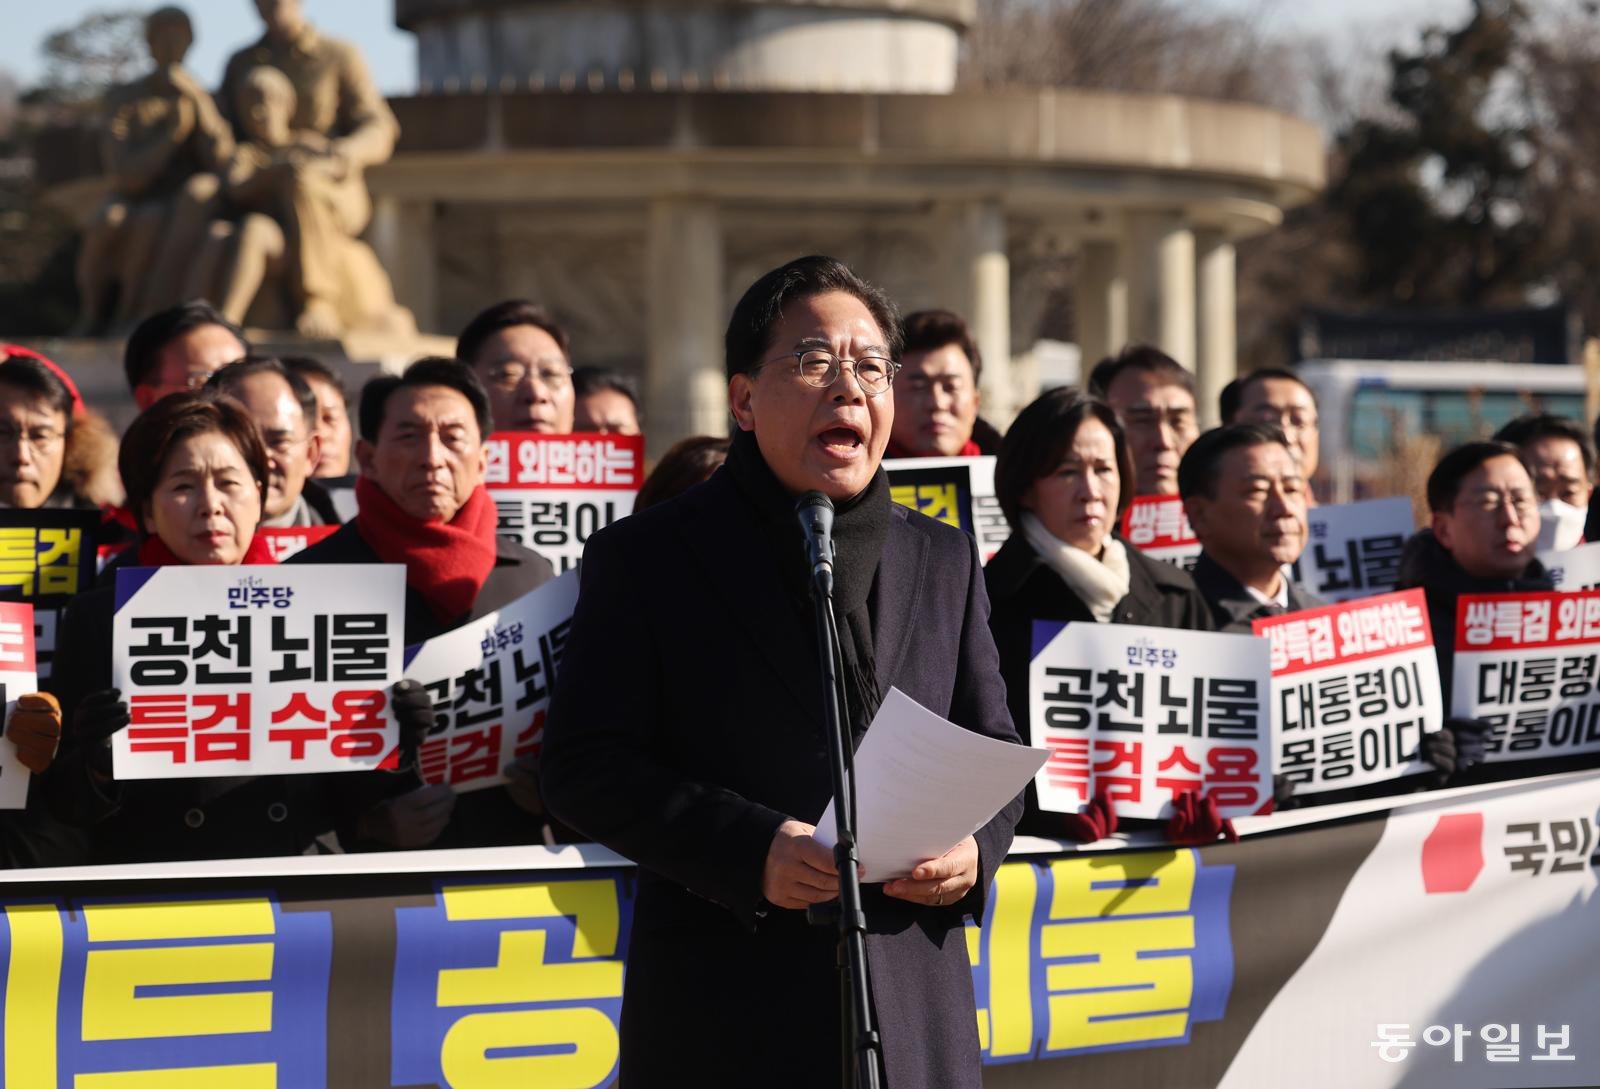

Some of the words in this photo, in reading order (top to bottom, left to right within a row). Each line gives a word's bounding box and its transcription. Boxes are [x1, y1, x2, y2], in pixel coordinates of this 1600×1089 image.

[517, 440, 635, 484] 외면하는
[1314, 534, 1404, 593] 뇌물
[228, 586, 294, 609] 민주당
[1465, 599, 1551, 645] 쌍특검
[128, 614, 252, 687] 공천
[269, 613, 390, 684] 뇌물
[481, 621, 524, 658] 민주당
[1127, 645, 1178, 669] 민주당
[1337, 601, 1426, 657] 외면하는
[1043, 667, 1144, 733] 공천
[1157, 674, 1260, 740] 뇌물
[1281, 661, 1424, 732] 대통령이
[1478, 654, 1600, 705] 대통령
[127, 692, 251, 764] 특검
[268, 690, 387, 761] 수용
[1280, 717, 1426, 783] 몸통이다
[1043, 736, 1143, 804] 특검
[1156, 745, 1261, 807] 수용
